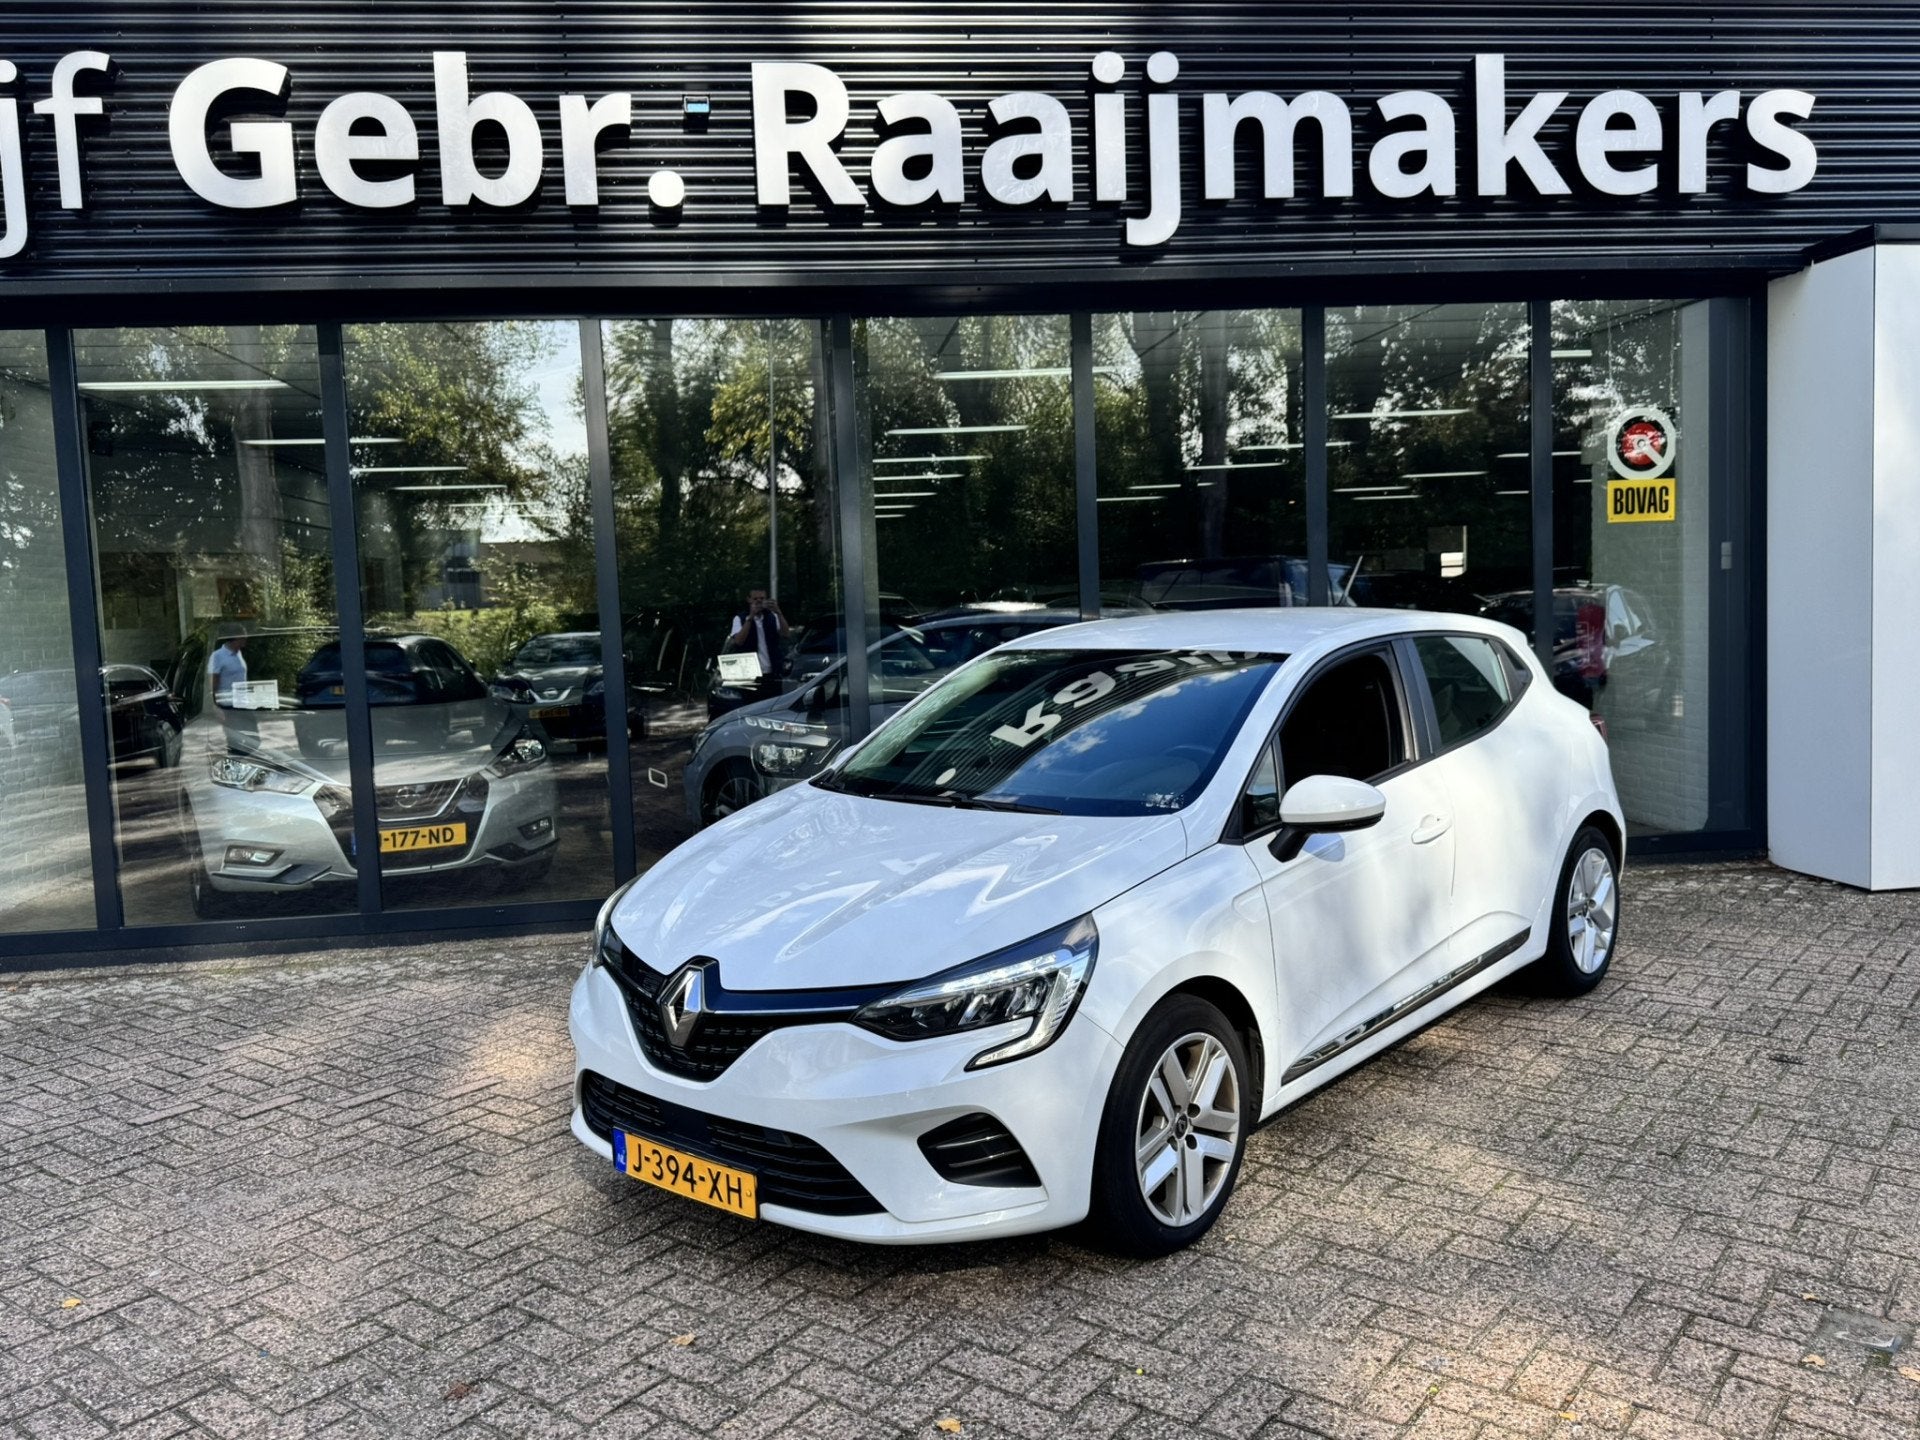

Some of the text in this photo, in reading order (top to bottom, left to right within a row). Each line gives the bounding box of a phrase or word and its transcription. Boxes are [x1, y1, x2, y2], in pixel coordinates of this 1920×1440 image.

[168, 51, 685, 208] Gebr.
[751, 51, 1817, 246] Raaijmakers
[1613, 485, 1669, 515] BOVAG
[380, 827, 455, 848] -177-ND
[632, 1143, 743, 1209] J-394-XH
